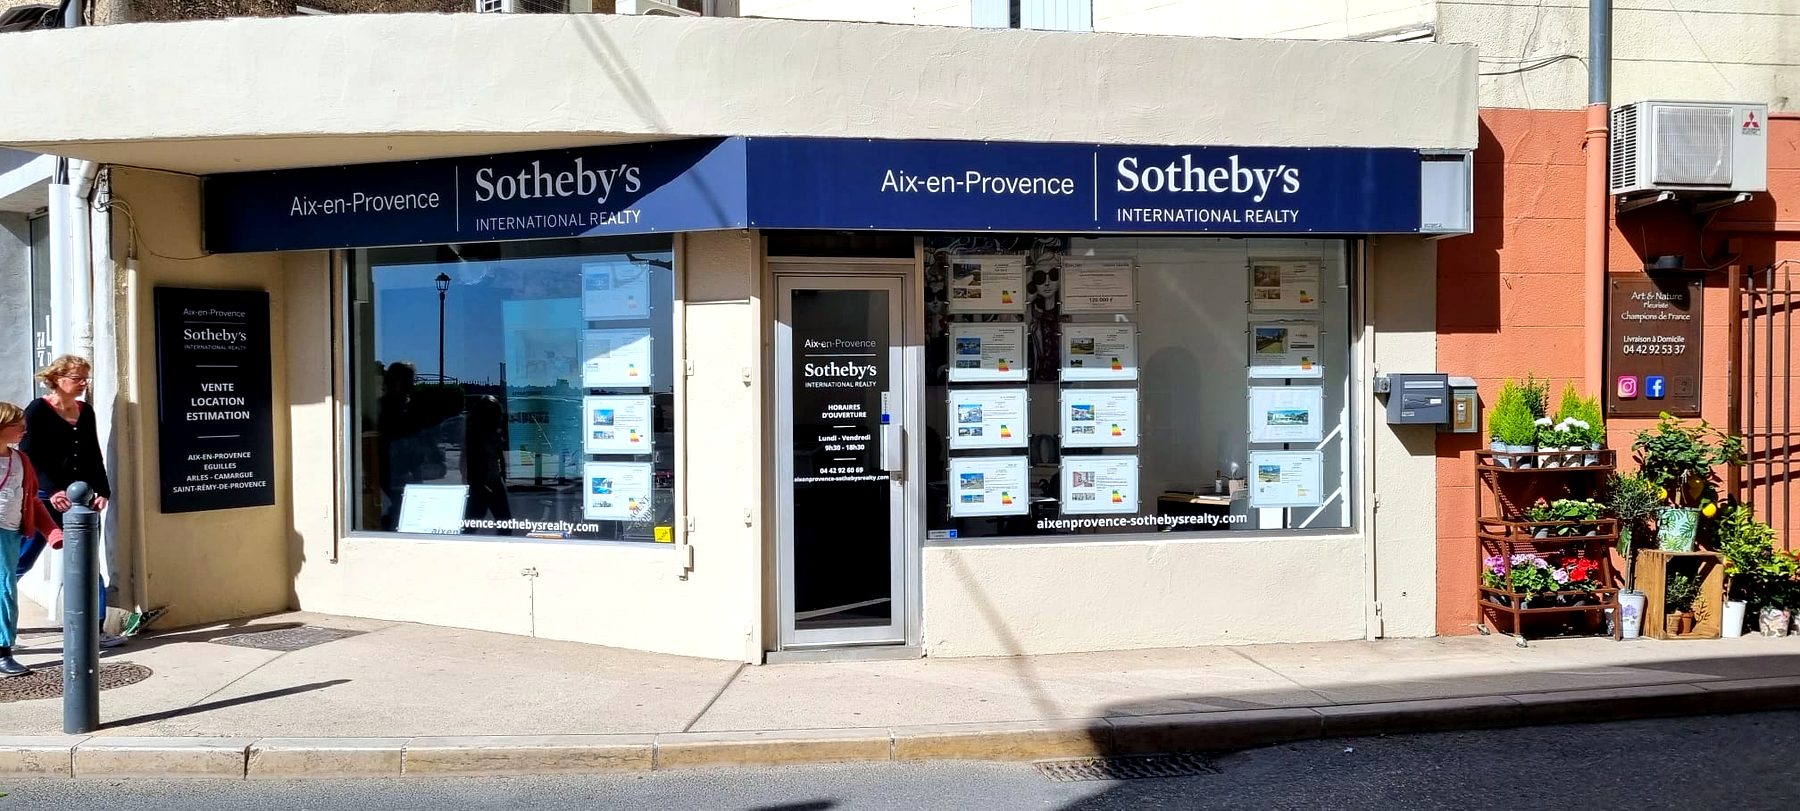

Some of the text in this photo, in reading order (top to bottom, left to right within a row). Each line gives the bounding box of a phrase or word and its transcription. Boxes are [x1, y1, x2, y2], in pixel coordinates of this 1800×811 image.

[476, 157, 641, 204] Sotheby's
[881, 170, 1073, 194] Aix-en-Provence
[1117, 153, 1300, 203] Sotheby's
[290, 191, 440, 217] Aix-en-Provence
[476, 210, 641, 231] INTERNATIONAL REALTY
[1117, 208, 1299, 223] INTERNATIONAL REALTY
[1630, 291, 1683, 301] Art & Nature
[183, 307, 246, 318] Aix-en-Provence
[1621, 311, 1691, 323] Champions de France
[183, 328, 247, 344] Sotheby's
[1623, 335, 1685, 343] Livraison à Domicile
[804, 338, 876, 349] Aix-en-Provence
[1623, 344, 1686, 355] 04 42 92 53 37
[805, 362, 876, 379] Sotheby's
[200, 382, 235, 392] VENTE
[854, 380, 877, 388] REALTY
[191, 396, 245, 407] LOCATION
[827, 403, 861, 411] HORAIRES
[186, 410, 250, 421] ESTIMATION
[821, 411, 867, 419] D'OUVERTURE
[818, 434, 838, 442] Lundi
[187, 451, 251, 461] AIX-EN-PROVENCE
[203, 462, 237, 471] EGUILLES
[819, 467, 828, 475] 04
[186, 474, 209, 482] ARLES
[213, 471, 254, 480] CAMARGUE
[173, 482, 267, 493] SAINT-RÉMY-DE-PROVENCE
[1036, 512, 1247, 530] aixenprovence-sothebysrealty.com
